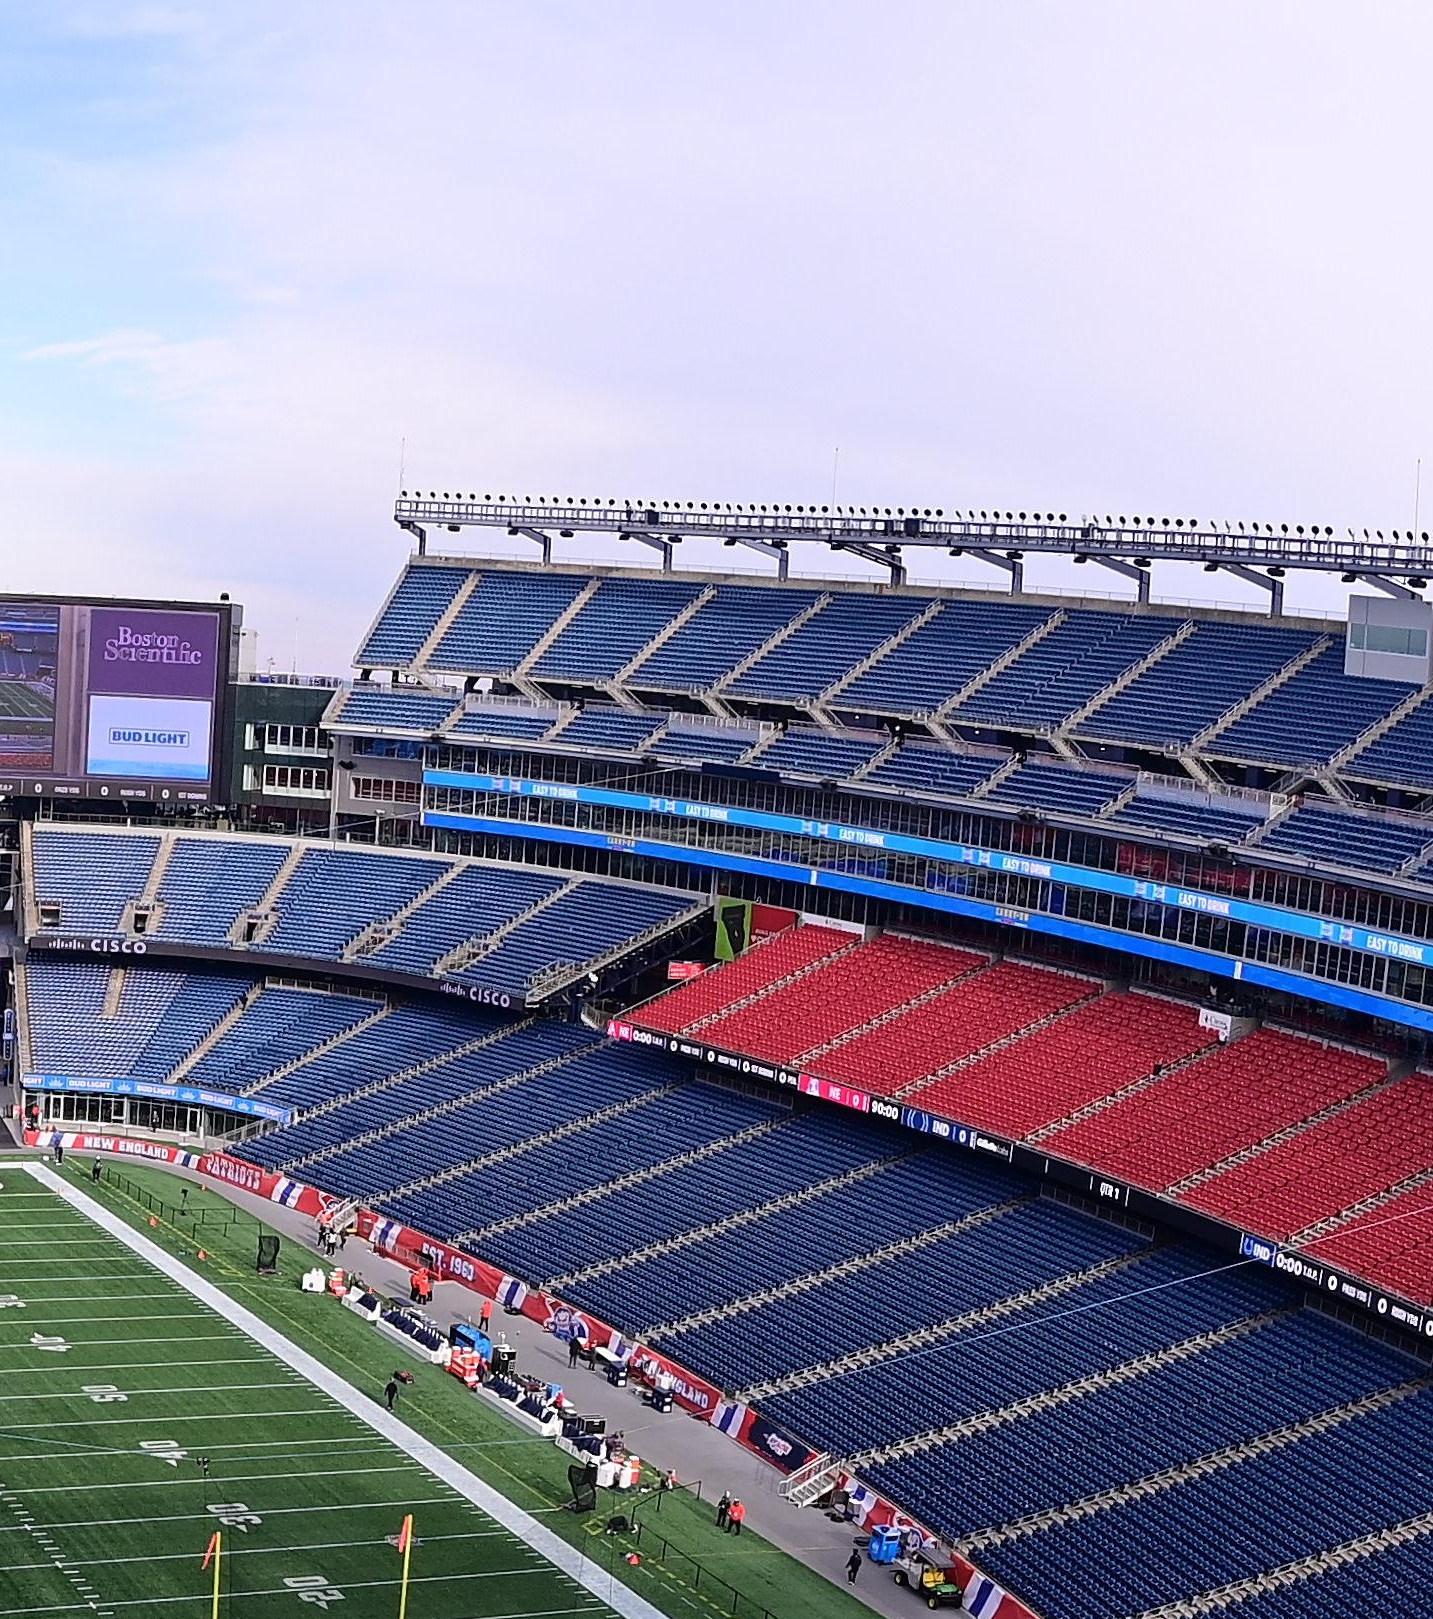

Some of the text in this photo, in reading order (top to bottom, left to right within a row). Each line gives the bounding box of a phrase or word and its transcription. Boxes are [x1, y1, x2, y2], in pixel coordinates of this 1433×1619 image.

[118, 626, 178, 647] Boston
[104, 639, 202, 664] Scientific
[112, 731, 187, 744] BUD LIGHT
[90, 940, 147, 954] CISCO
[470, 987, 511, 1008] CISCO
[871, 1100, 898, 1120] 90:00
[84, 1136, 168, 1160] NEW ENGLAND
[206, 1153, 261, 1190] PATRIOTS
[449, 1255, 475, 1282] 1960
[1276, 1253, 1302, 1276] 0:00
[1328, 1275, 1337, 1290] 0
[1378, 1299, 1387, 1313] 0
[282, 1575, 346, 1602] 20
